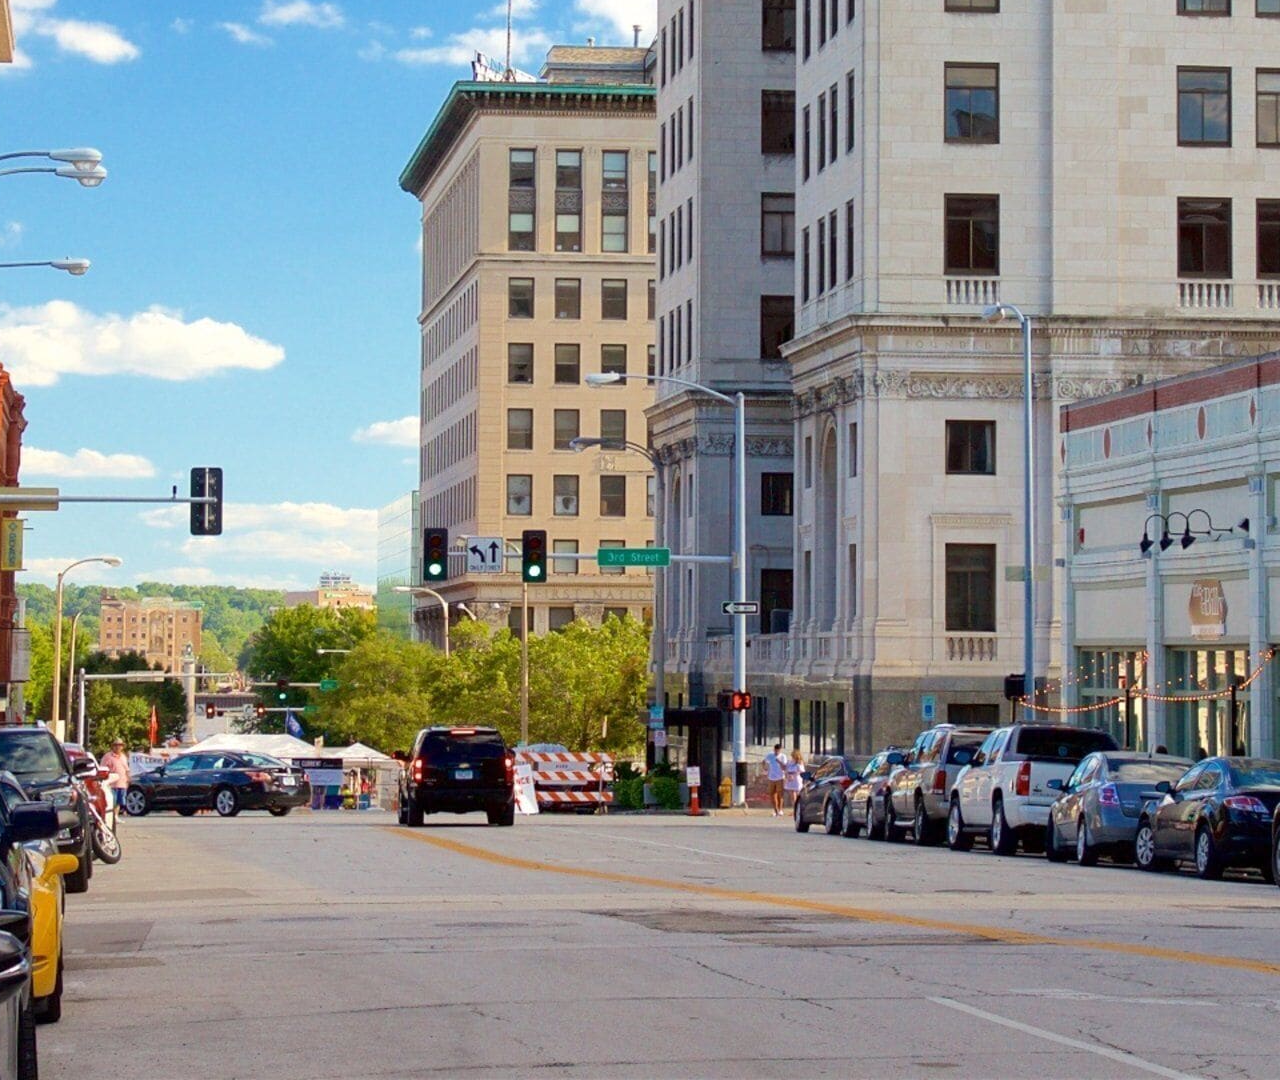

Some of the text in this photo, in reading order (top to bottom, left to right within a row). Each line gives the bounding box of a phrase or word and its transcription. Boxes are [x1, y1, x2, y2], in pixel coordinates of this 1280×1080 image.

[607, 551, 660, 563] 3rd Street
[534, 589, 655, 600] FIRST NATIO
